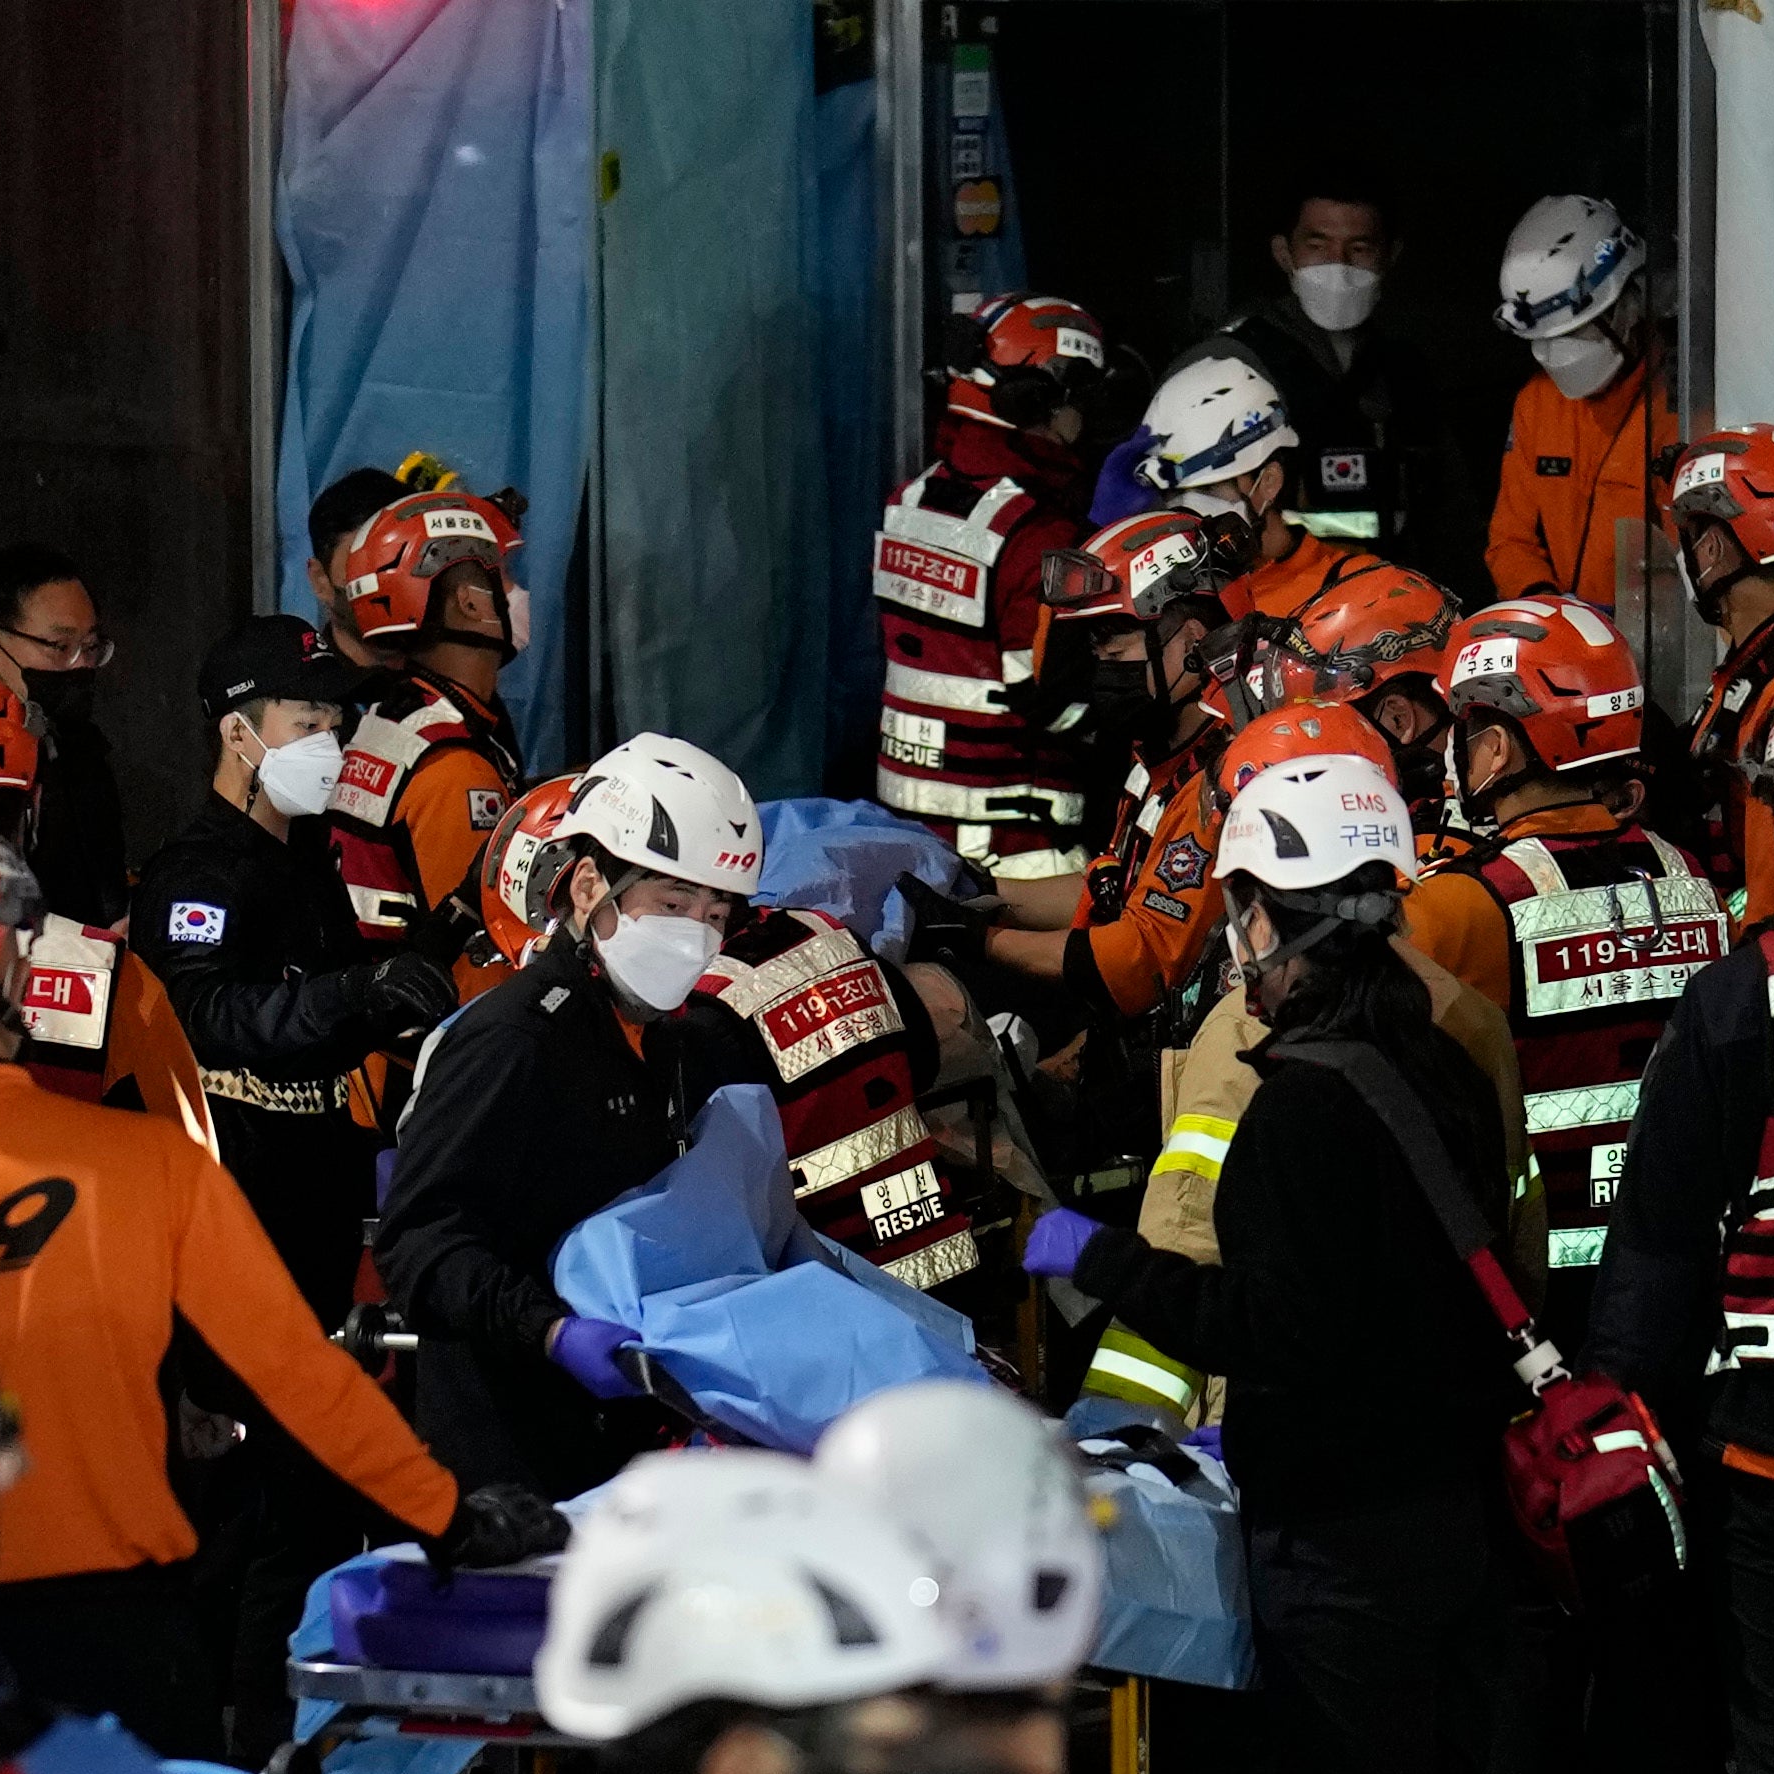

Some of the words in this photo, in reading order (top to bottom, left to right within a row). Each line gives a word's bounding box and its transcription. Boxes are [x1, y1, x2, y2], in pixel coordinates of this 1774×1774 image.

[1134, 549, 1155, 574] 119
[1460, 644, 1482, 664] 119
[1467, 655, 1514, 675] 구조대
[1340, 793, 1387, 813] EMS
[1340, 825, 1400, 848] 구급대
[714, 851, 757, 873] 119
[1556, 926, 1710, 971] 119구조대
[780, 974, 880, 1033] 119구조대
[816, 1011, 883, 1053] 서울소방
[875, 1196, 945, 1242] RESCUE
